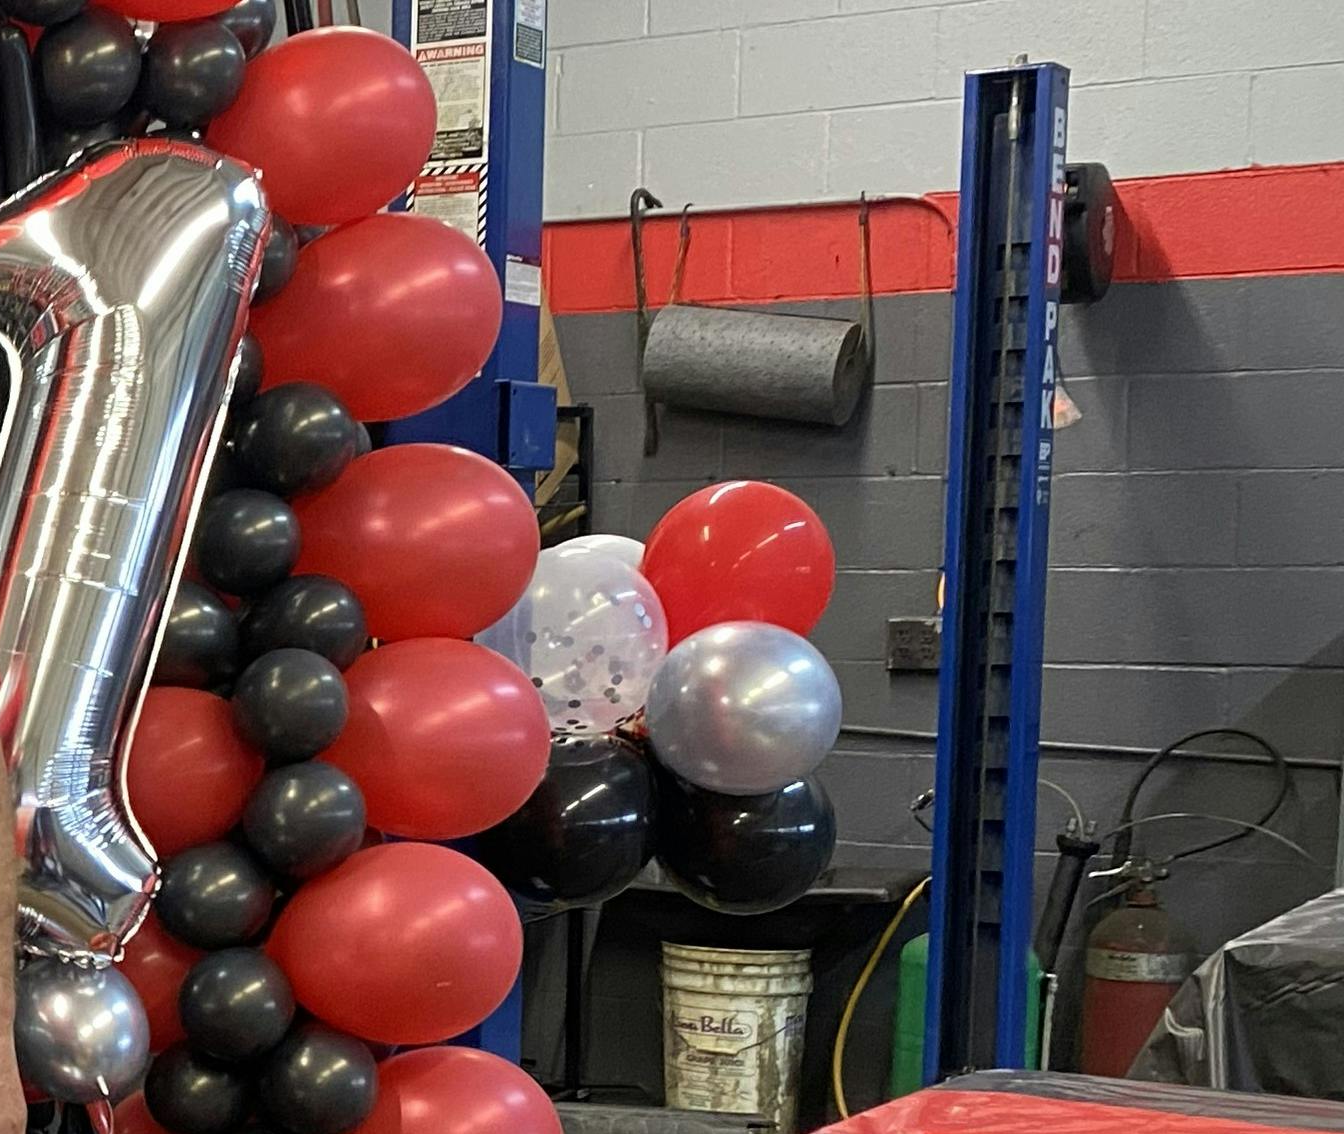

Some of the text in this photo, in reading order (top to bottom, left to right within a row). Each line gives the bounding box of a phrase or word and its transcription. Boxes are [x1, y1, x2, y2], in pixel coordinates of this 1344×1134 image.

[426, 44, 485, 60] WARNING
[1046, 106, 1066, 285] BEND
[1040, 301, 1058, 429] PAK
[700, 1015, 745, 1035] Bella
